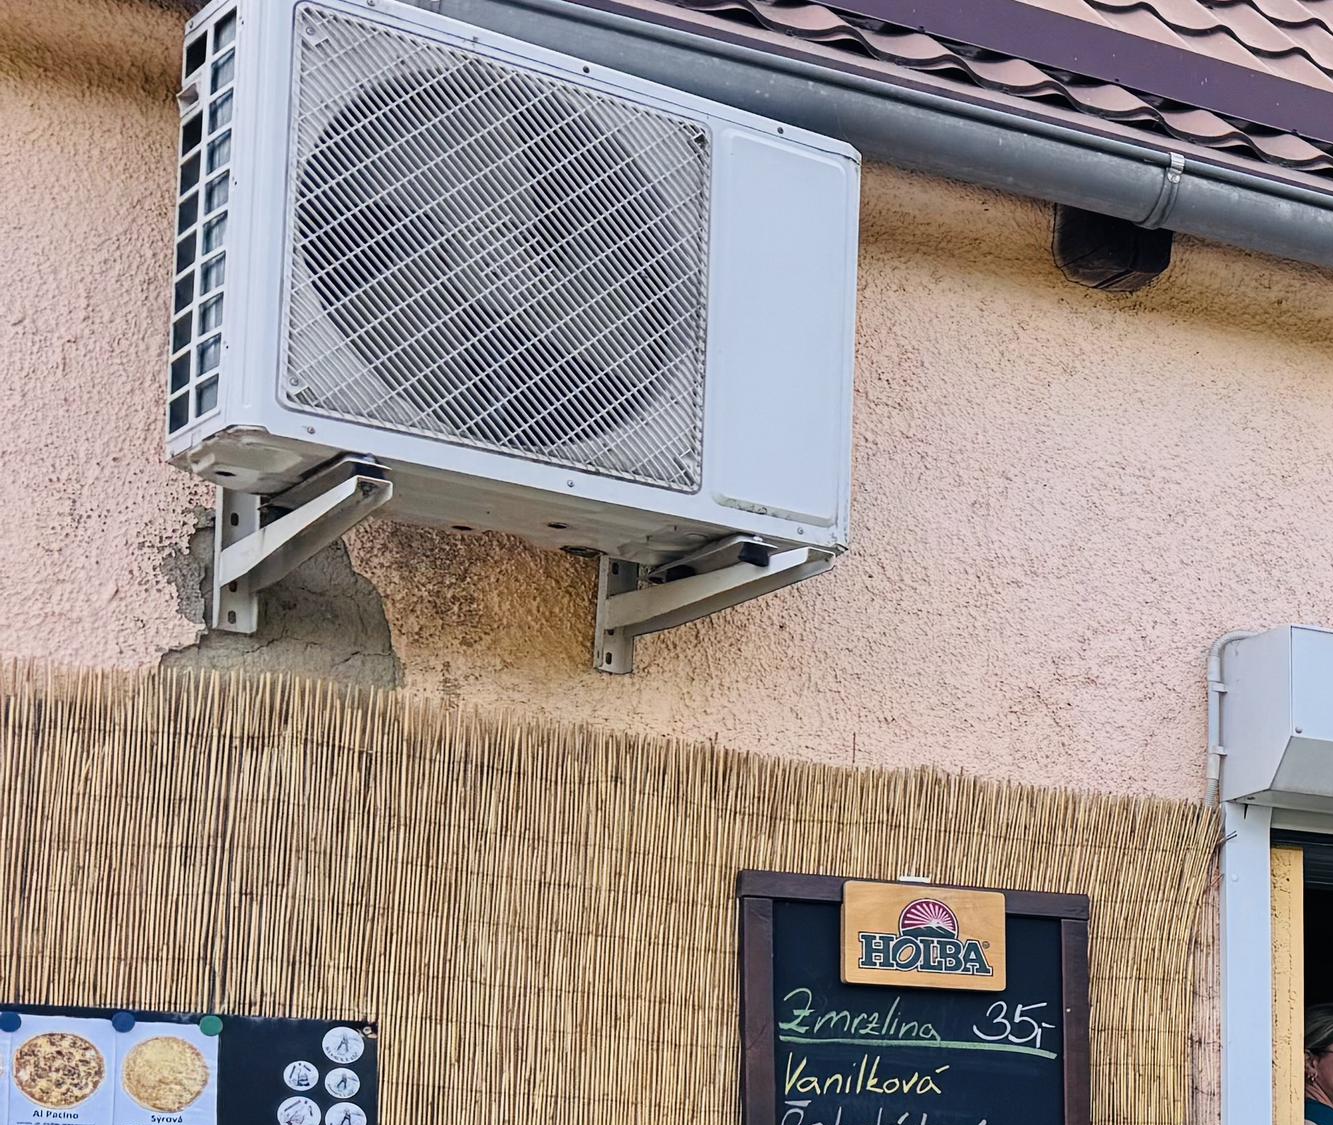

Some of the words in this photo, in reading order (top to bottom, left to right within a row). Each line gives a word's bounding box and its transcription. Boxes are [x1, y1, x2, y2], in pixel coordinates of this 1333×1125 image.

[857, 931, 993, 977] HOLBA
[779, 988, 941, 1040] Zmrzlina
[784, 1052, 951, 1095] Vanilková
